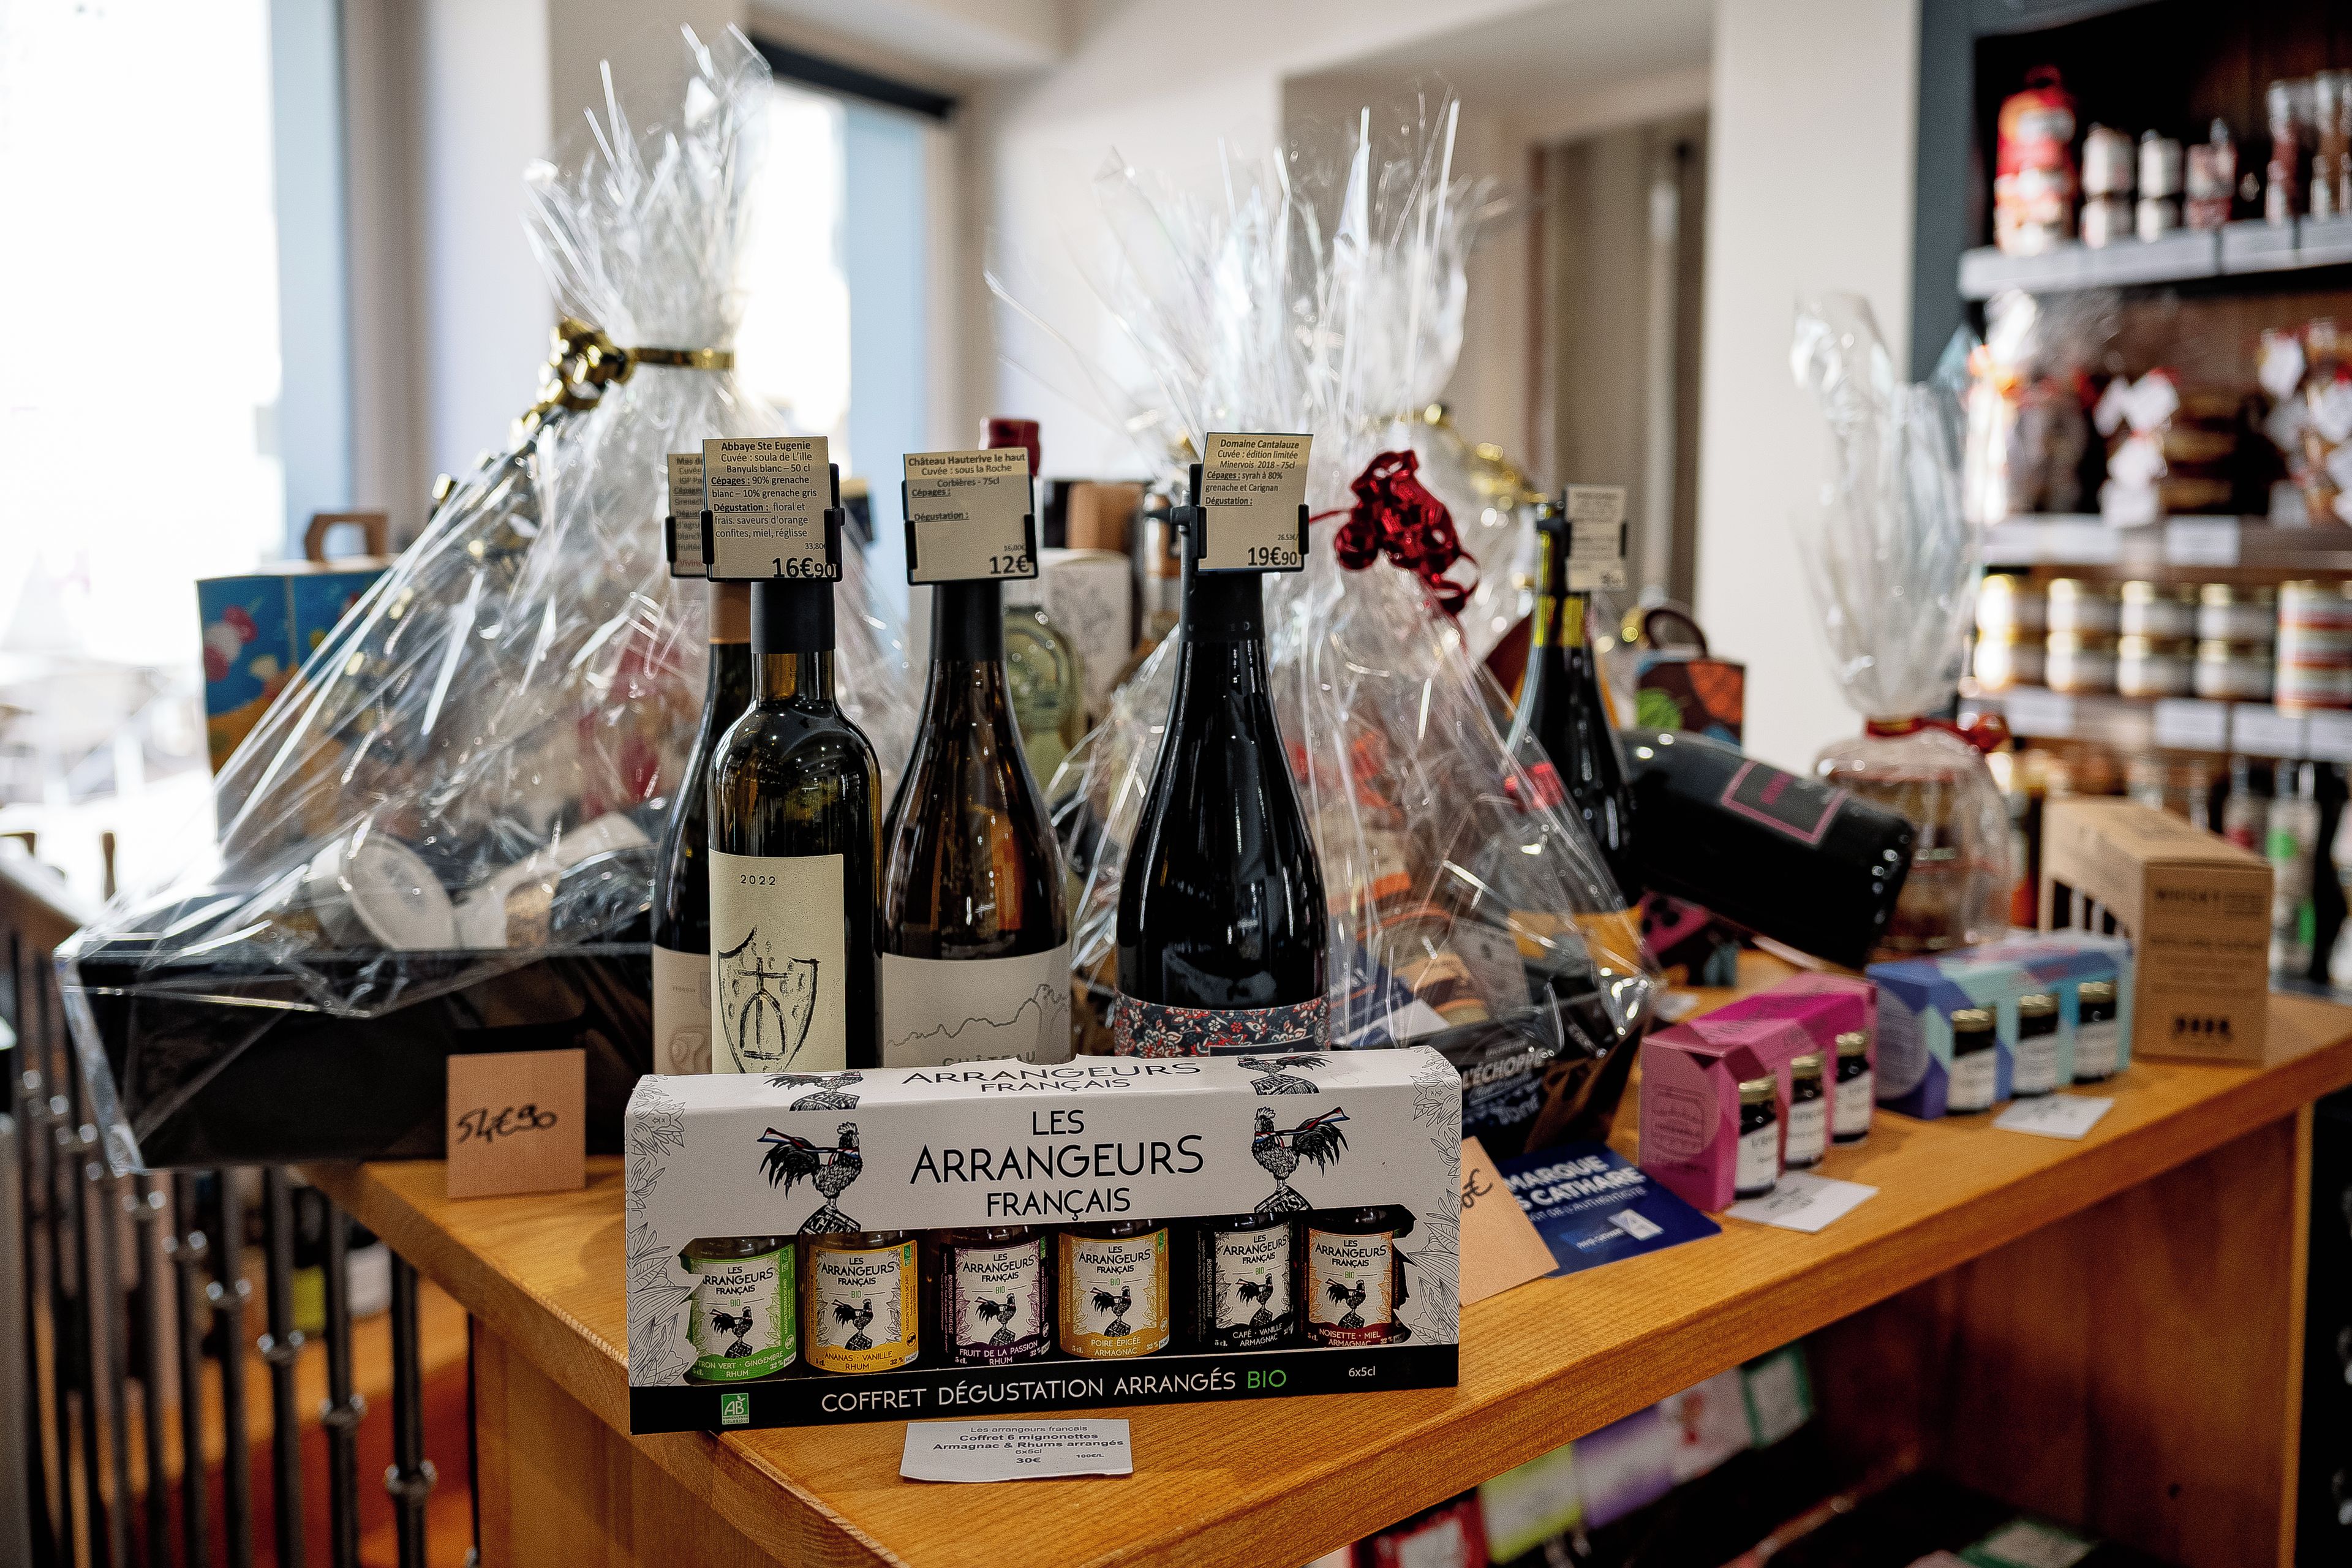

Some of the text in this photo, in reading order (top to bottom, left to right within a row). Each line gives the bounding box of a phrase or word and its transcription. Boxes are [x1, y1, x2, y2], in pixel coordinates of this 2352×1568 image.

[721, 442, 755, 451] Abbaye
[775, 441, 810, 451] Eugenie
[1220, 439, 1299, 449] Domaine Cantalauze
[1246, 450, 1272, 459] édition
[909, 458, 945, 466] Château
[948, 455, 992, 464] Hauterive
[1207, 471, 1237, 480] Cépages
[1242, 472, 1260, 480] syrah
[711, 477, 745, 485] Cépages
[772, 477, 809, 486] grenache
[937, 477, 1000, 488] Corbières 75cl
[762, 489, 799, 499] grenache
[1249, 484, 1278, 493] Carignan
[1205, 497, 1248, 506] Dégustation
[714, 503, 763, 512] Dégustation
[914, 513, 964, 521] Dégustation
[715, 529, 807, 538] confites, miel, réglisse
[990, 555, 1029, 574] 12€
[741, 875, 776, 885] 2022
[902, 1063, 1202, 1085] ARRANGEURS
[981, 1079, 1131, 1093] FRANÇAIS
[1033, 1109, 1084, 1136] LES
[910, 1134, 1204, 1185] ARRANGEURS
[987, 1187, 1130, 1221] FRANÇAIS
[1223, 1234, 1289, 1256] ARRANGEURS
[1315, 1243, 1386, 1258] ARRANGEURS
[1079, 1249, 1150, 1264] ARRANGEURS
[1242, 1252, 1275, 1264] FRANÇAIS
[821, 1262, 894, 1276] ARRANGEURS
[962, 1254, 1035, 1273] ARRANGEURS
[1332, 1259, 1369, 1268] FRANÇAIS
[1097, 1265, 1134, 1275] FRANÇAIS
[838, 1278, 876, 1287] FRANÇAIS
[981, 1272, 1019, 1282] FRANÇAIS
[716, 1285, 755, 1295] FRANÇAIS
[1233, 1330, 1251, 1338] CAFÉ
[1259, 1323, 1283, 1335] VANILLE
[1319, 1329, 1356, 1339] NOISETTE
[1117, 1336, 1140, 1346] ÉPICÉE
[1240, 1333, 1278, 1346] ARMAGNAC
[1010, 1340, 1038, 1354] PASSION
[745, 1351, 783, 1367] GINGEMBRE
[862, 1351, 892, 1361] VANILLE
[1348, 1365, 1376, 1378] 6x5cl
[821, 1368, 1286, 1412] COFFRET DÉGUSTATION ARRANGÉS BIO
[724, 1401, 744, 1415] AB
